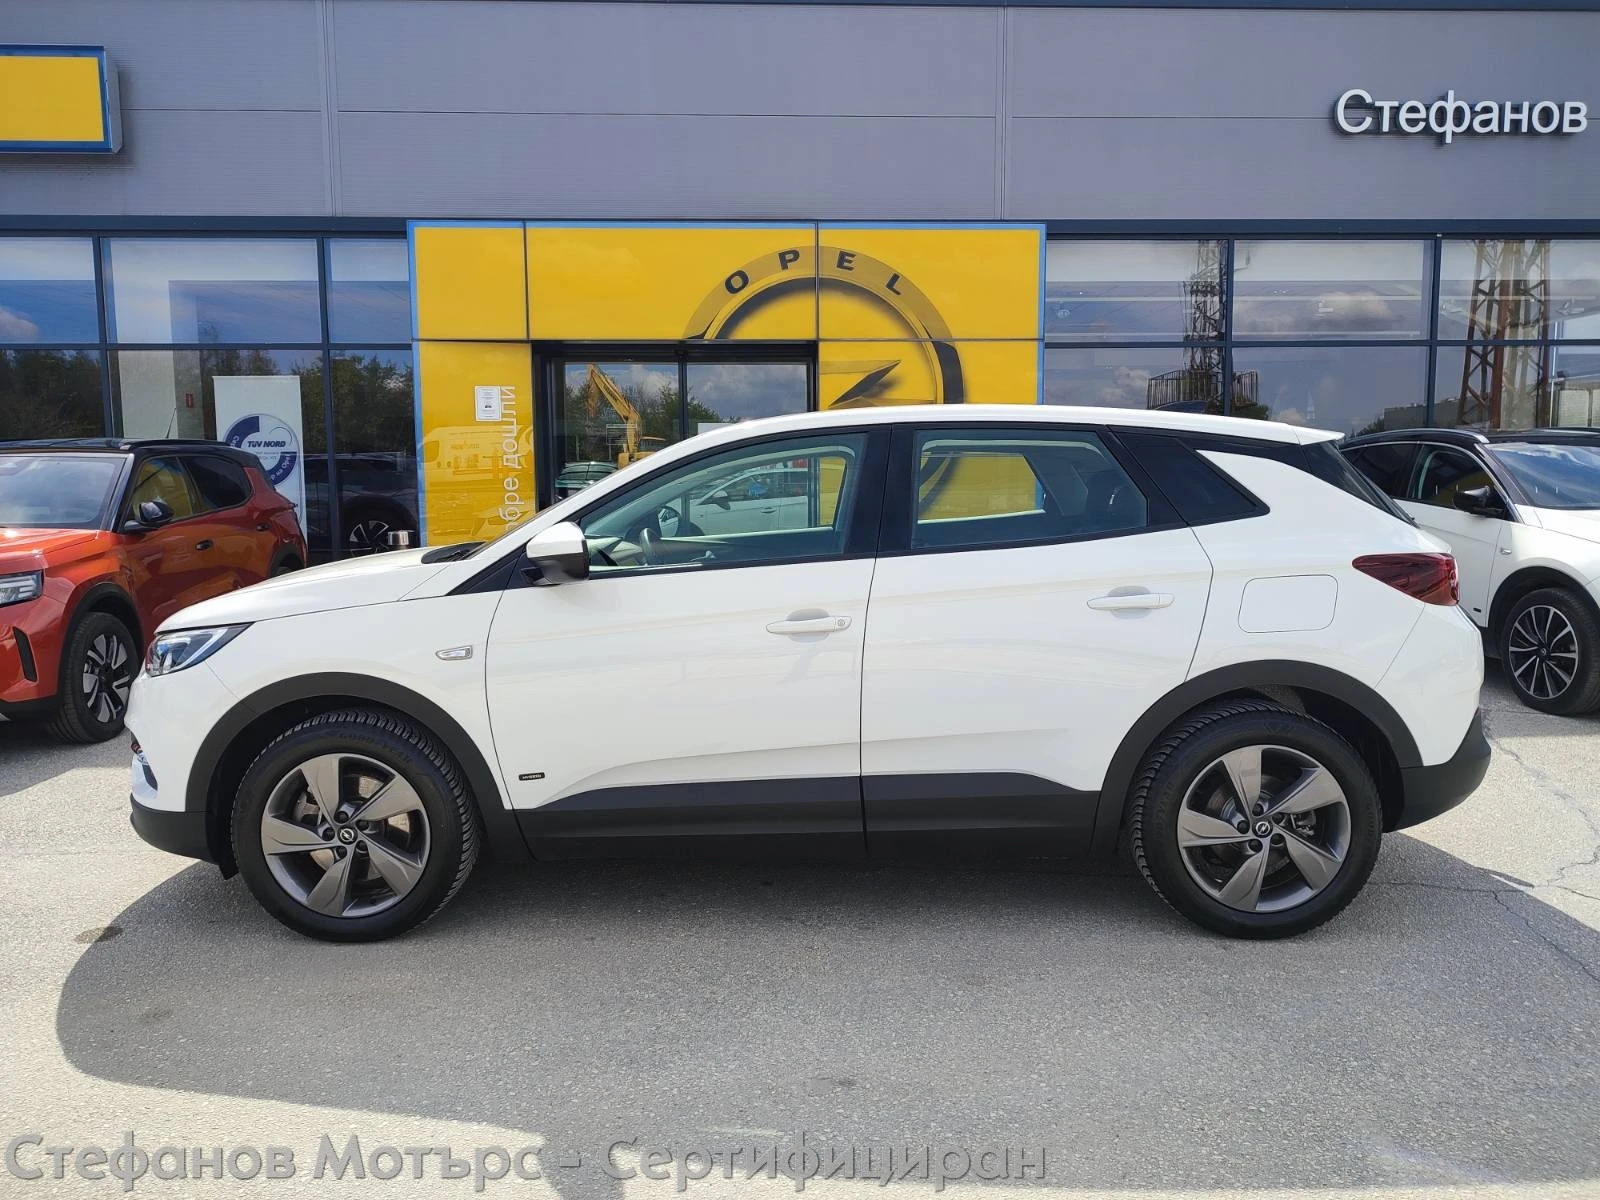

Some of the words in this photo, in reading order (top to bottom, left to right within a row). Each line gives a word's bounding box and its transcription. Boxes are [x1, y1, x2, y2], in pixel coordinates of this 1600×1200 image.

[1336, 88, 1588, 144] Стефанов
[724, 249, 902, 296] OPEL
[247, 440, 263, 448] TÜV
[263, 440, 287, 448] NORD
[500, 386, 522, 469] дошли
